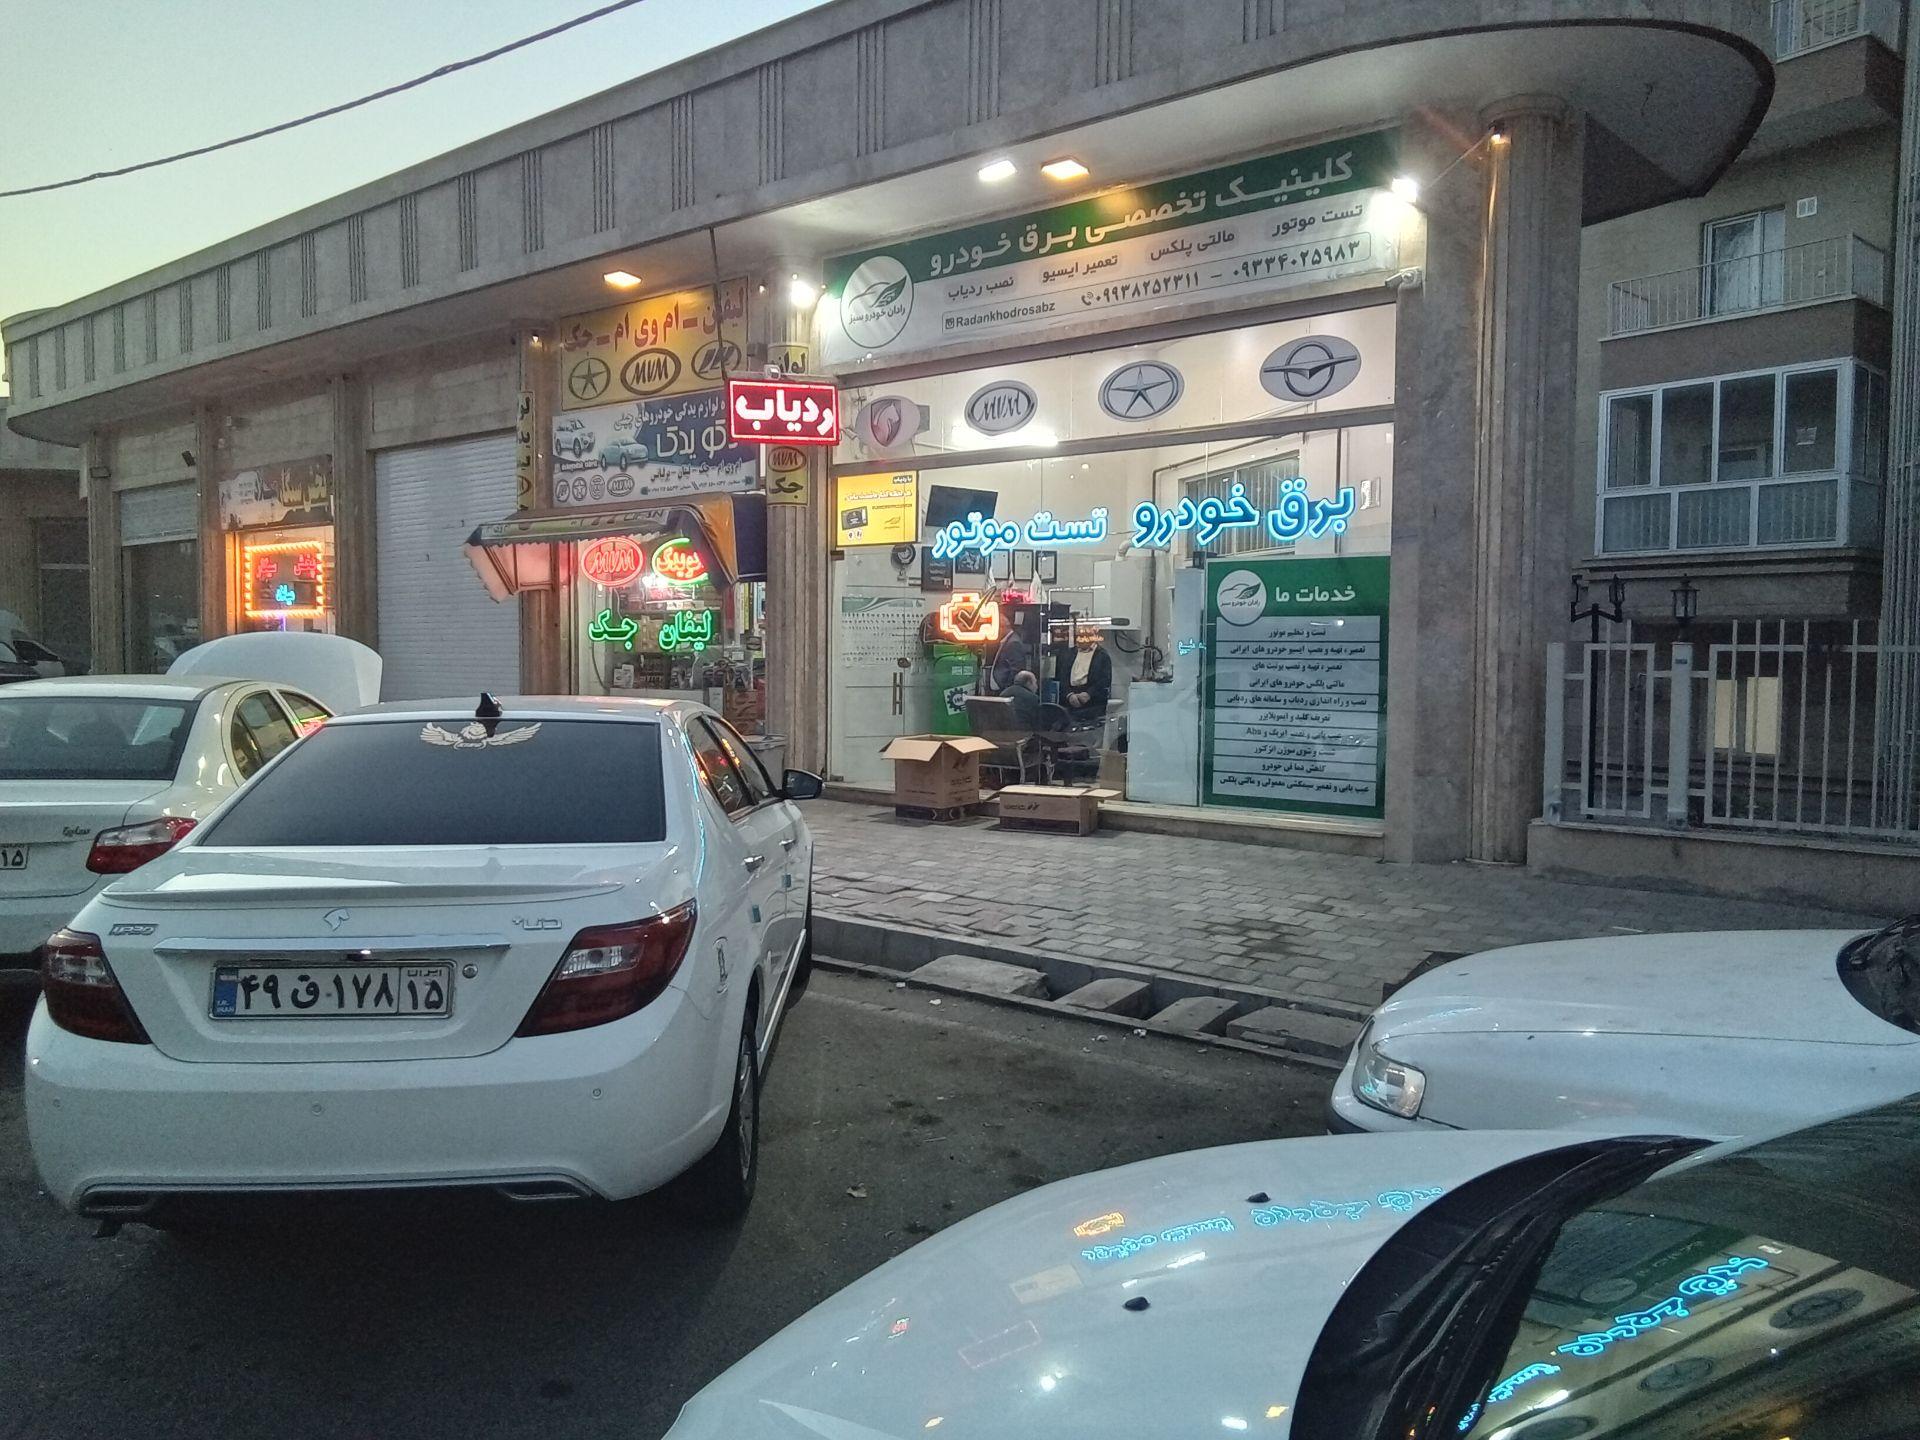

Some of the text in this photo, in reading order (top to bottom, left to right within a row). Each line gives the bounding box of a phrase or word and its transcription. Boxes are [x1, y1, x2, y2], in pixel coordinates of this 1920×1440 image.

[930, 151, 1353, 276] کلینیک تخصصی برق خودرو
[1272, 205, 1363, 237] تست موتور
[1150, 229, 1235, 262] مالتی پلکس
[1042, 254, 1118, 283] تعمیر ایسیو
[948, 276, 1014, 301] نصب ردیاب
[864, 308, 888, 321] خودرو
[886, 306, 906, 319] رادان
[955, 301, 1056, 328] Radankhodrosabz
[634, 316, 658, 348] وی
[630, 355, 670, 386] MVM
[735, 389, 834, 435] ردیاب
[769, 476, 804, 498] جک
[1132, 476, 1357, 555] برق خودرو
[931, 508, 1109, 559] تست موتور
[1275, 585, 1356, 602] خدمات ما
[588, 608, 713, 650] لیفان جک
[1249, 679, 1269, 688] ایرانی
[1270, 680, 1283, 688] های
[1284, 681, 1305, 689] خودرو
[1, 848, 24, 867] ۱۵
[407, 968, 443, 977] ایران
[290, 973, 320, 1010] ق
[332, 972, 395, 1010] ۱۷۸
[407, 978, 445, 1010] ۱۵
